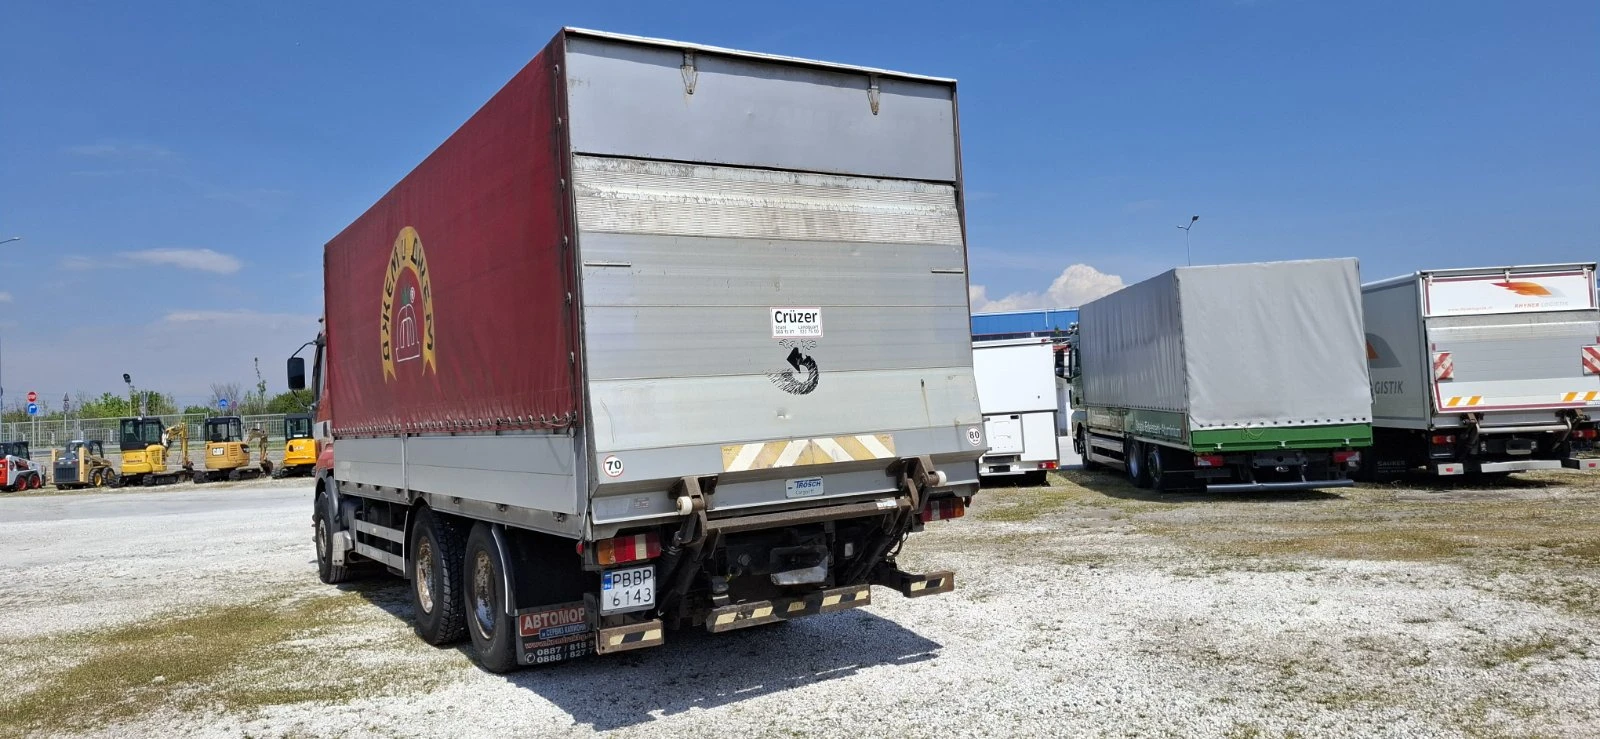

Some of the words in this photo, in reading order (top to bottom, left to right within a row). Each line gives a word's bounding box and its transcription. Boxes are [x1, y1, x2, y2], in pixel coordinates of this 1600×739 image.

[774, 310, 818, 323] Crüzer
[1372, 380, 1404, 395] GISTIK
[970, 431, 980, 439] 80
[213, 448, 224, 456] CAT
[606, 460, 622, 471] 70
[612, 587, 651, 607] 6143
[536, 654, 562, 664] 0888
[570, 649, 586, 658] 827
[537, 646, 562, 656] 0887
